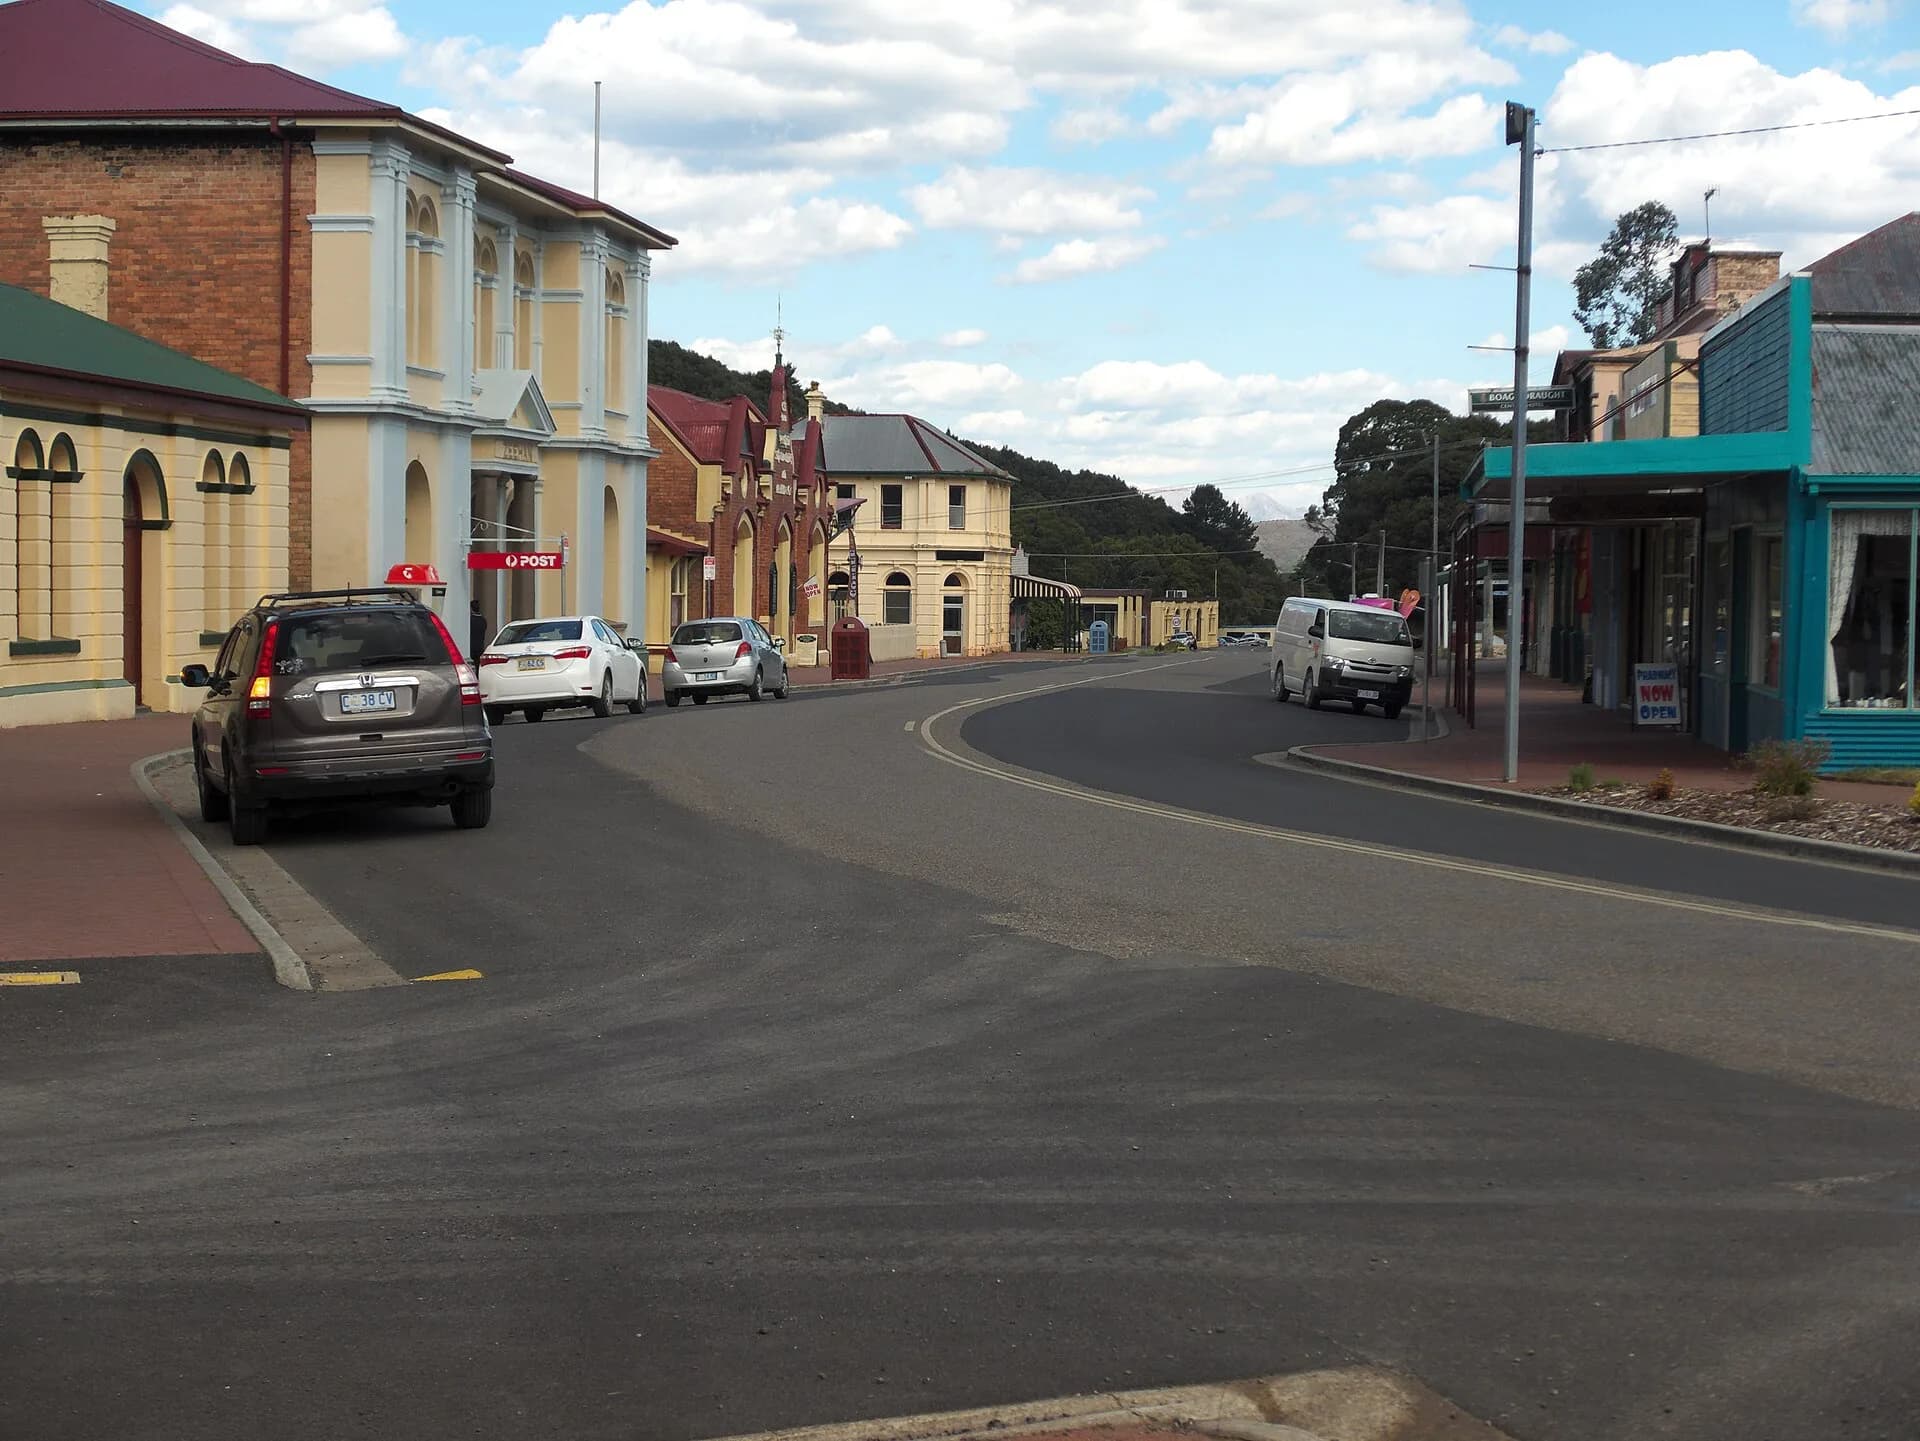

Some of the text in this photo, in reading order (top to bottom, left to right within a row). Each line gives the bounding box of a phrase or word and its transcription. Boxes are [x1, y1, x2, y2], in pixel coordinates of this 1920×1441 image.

[1489, 392, 1515, 401] BOAG
[520, 555, 556, 568] POST
[805, 590, 821, 598] OPEN
[1640, 684, 1674, 702] NOW
[342, 692, 393, 708] C 38 CV
[1640, 705, 1677, 719] OPEN
